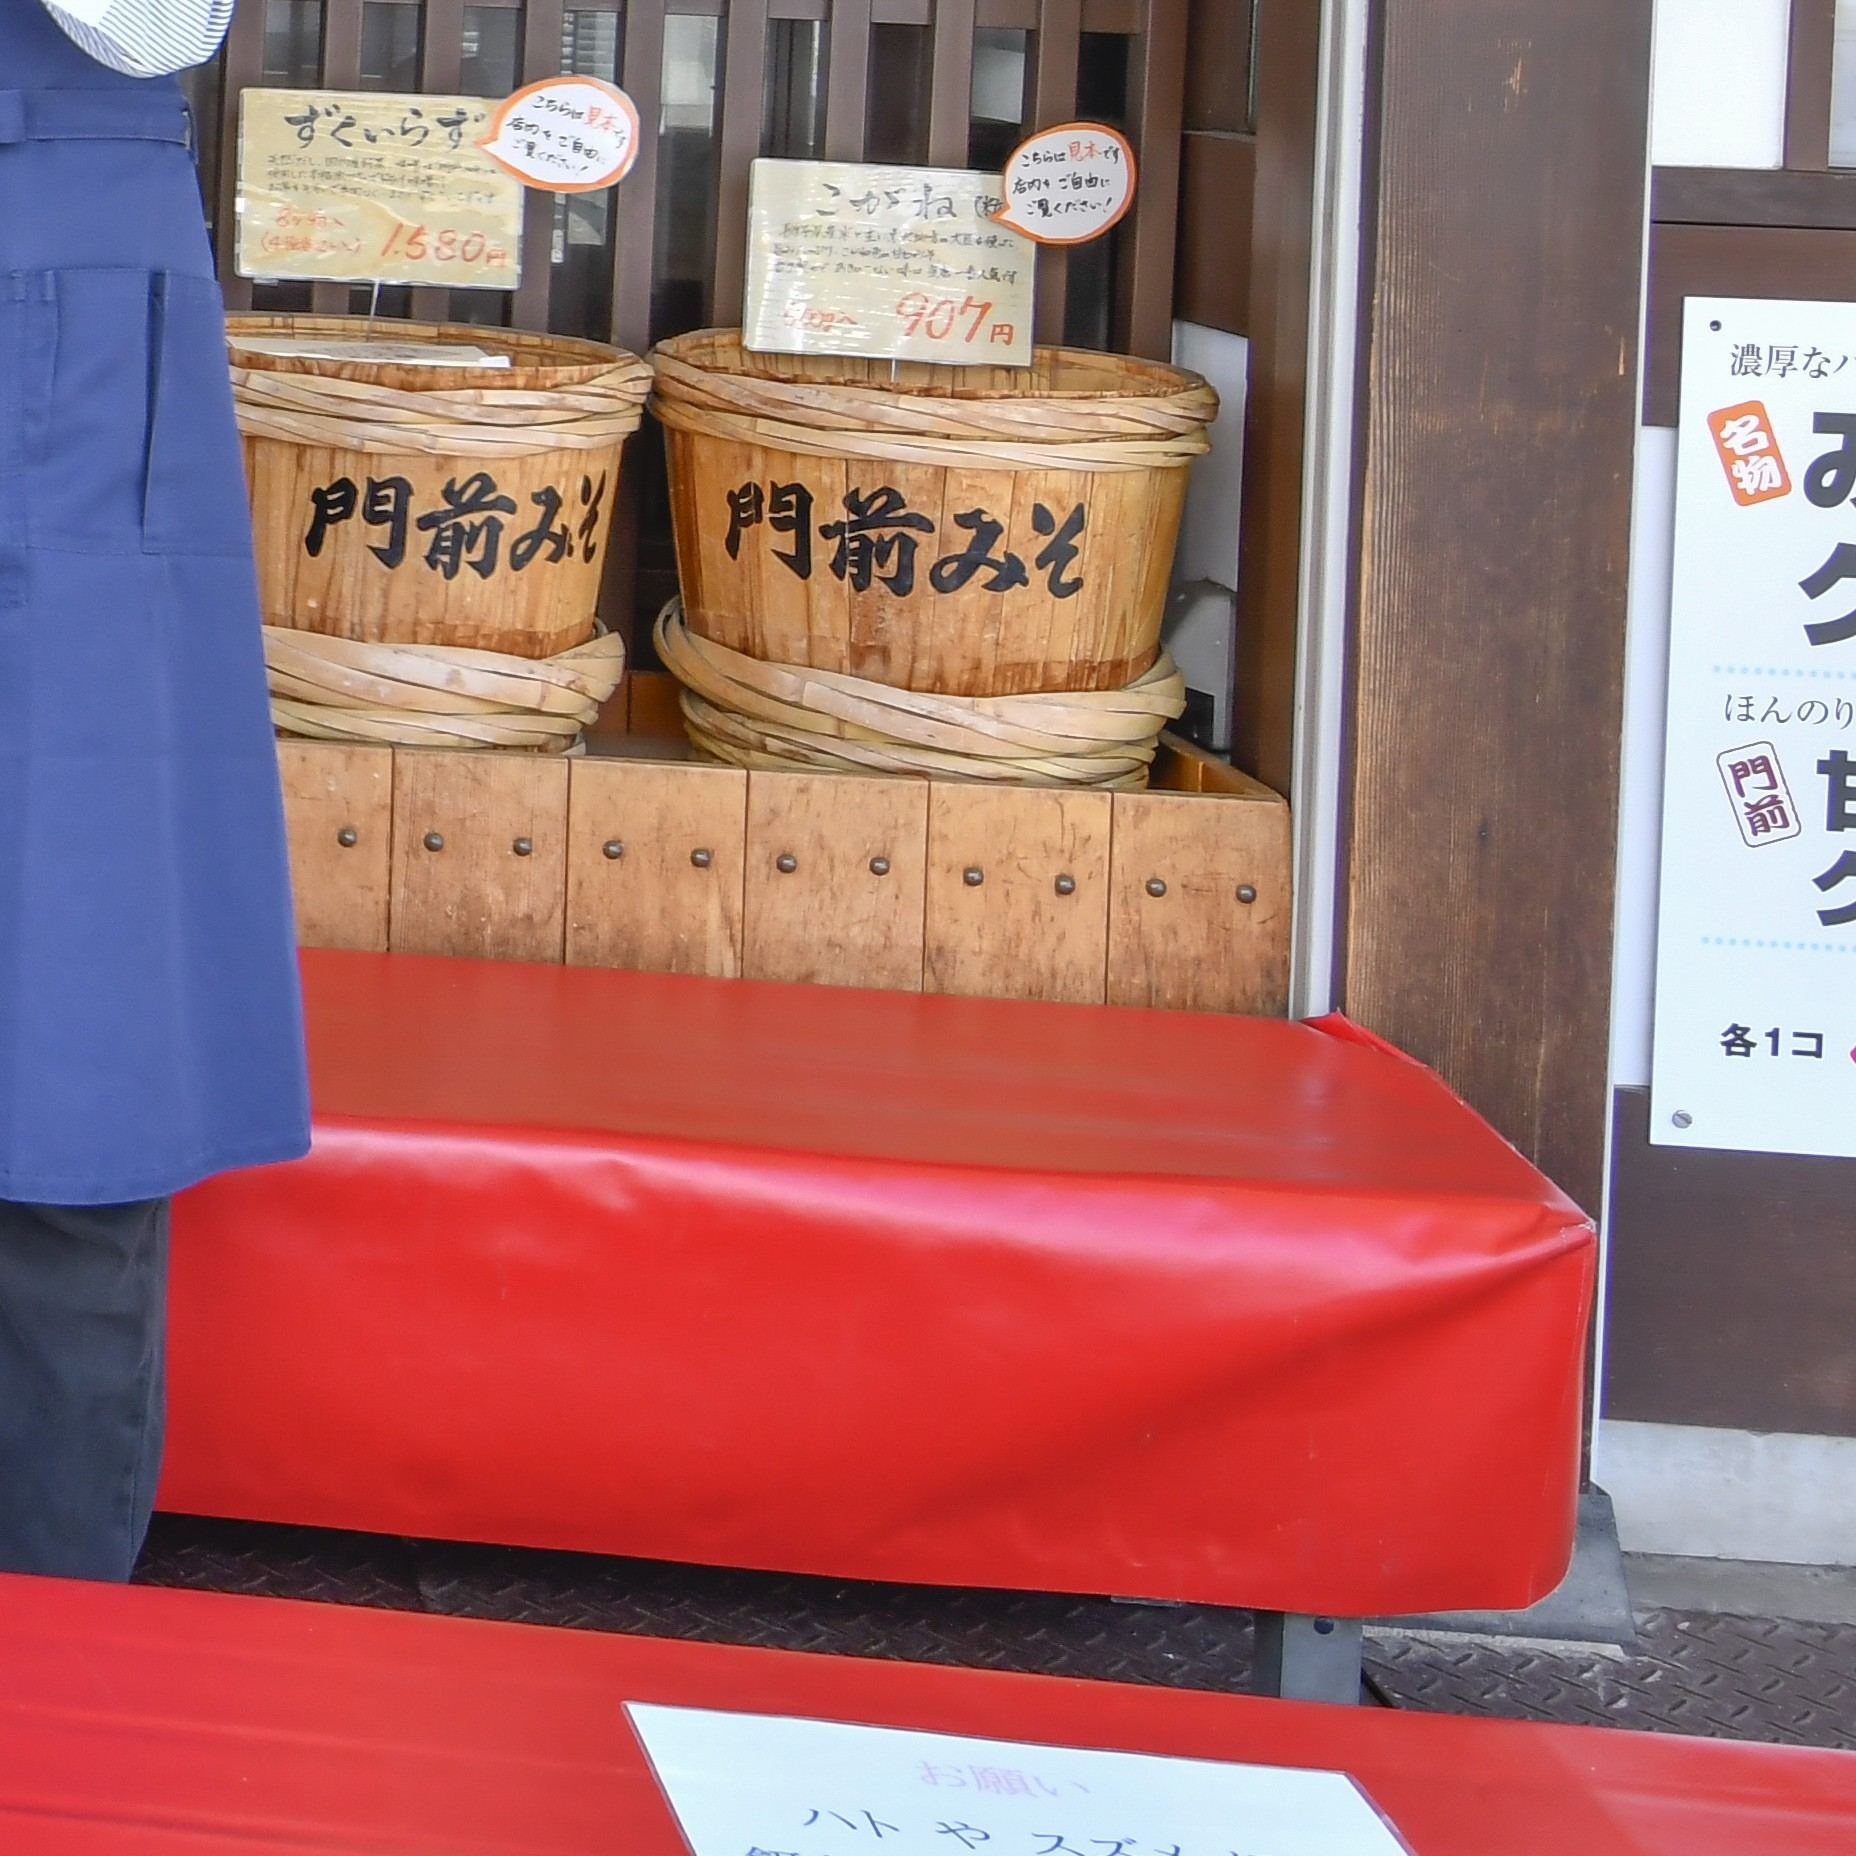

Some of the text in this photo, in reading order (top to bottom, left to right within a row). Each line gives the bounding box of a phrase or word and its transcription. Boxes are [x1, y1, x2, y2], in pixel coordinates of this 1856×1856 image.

[815, 182, 959, 220] こがね
[894, 291, 1015, 347] 907円
[1719, 413, 1783, 496] 名物
[304, 469, 607, 581] 門前みそ
[724, 479, 1085, 599] 門前みそ
[1724, 693, 1854, 730] ほんのり
[1727, 755, 1790, 837] 門前
[1719, 1022, 1824, 1059] 各1コ
